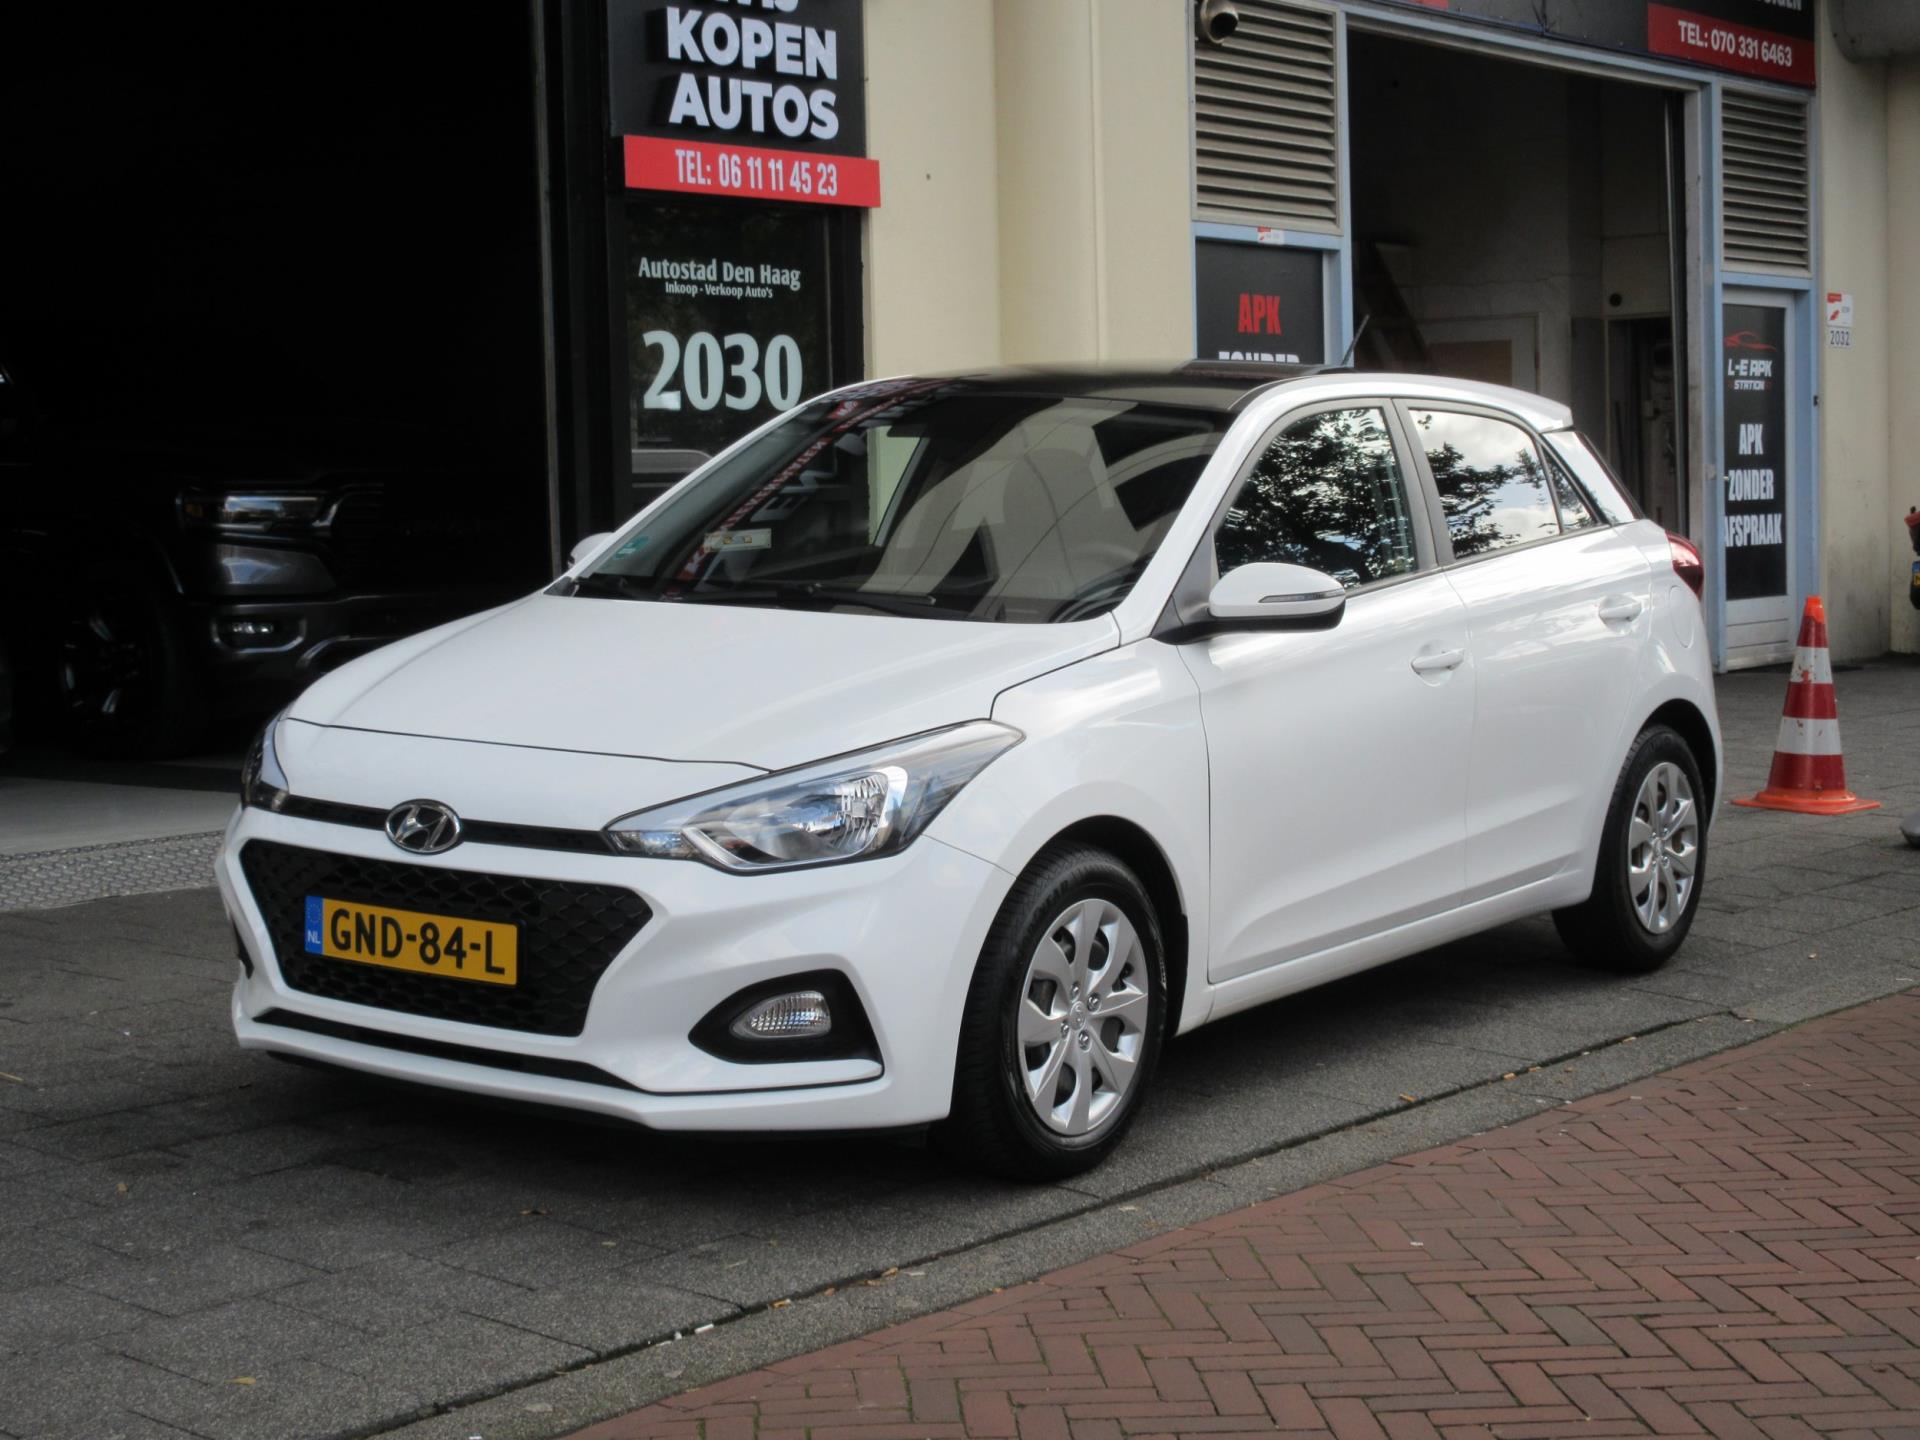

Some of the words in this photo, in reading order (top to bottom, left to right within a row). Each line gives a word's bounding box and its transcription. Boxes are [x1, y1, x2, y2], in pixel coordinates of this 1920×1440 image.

[667, 6, 837, 80] KOPEN
[1678, 20, 1708, 48] TEL:
[1711, 29, 1736, 54] 070
[1738, 35, 1759, 60] 331
[1761, 41, 1792, 67] 6463
[669, 72, 839, 140] AUTOS
[675, 149, 711, 185] TEL:
[718, 153, 741, 188] 06
[747, 157, 763, 190] 11
[768, 159, 784, 192] 11
[790, 161, 812, 194] 45
[817, 163, 838, 196] 23
[638, 257, 717, 280] Autostad
[722, 262, 755, 284] Den
[760, 264, 801, 291] Haag
[665, 281, 698, 298] Inkoop
[705, 284, 743, 300] Verkoop
[745, 285, 773, 299] Auto's
[1238, 292, 1282, 335] APK
[642, 330, 803, 411] 2030
[1749, 360, 1773, 377] APK
[1738, 424, 1764, 456] APK
[1728, 469, 1774, 501] ZONDER
[308, 930, 321, 944] NL
[331, 908, 506, 975] GND-84-L
